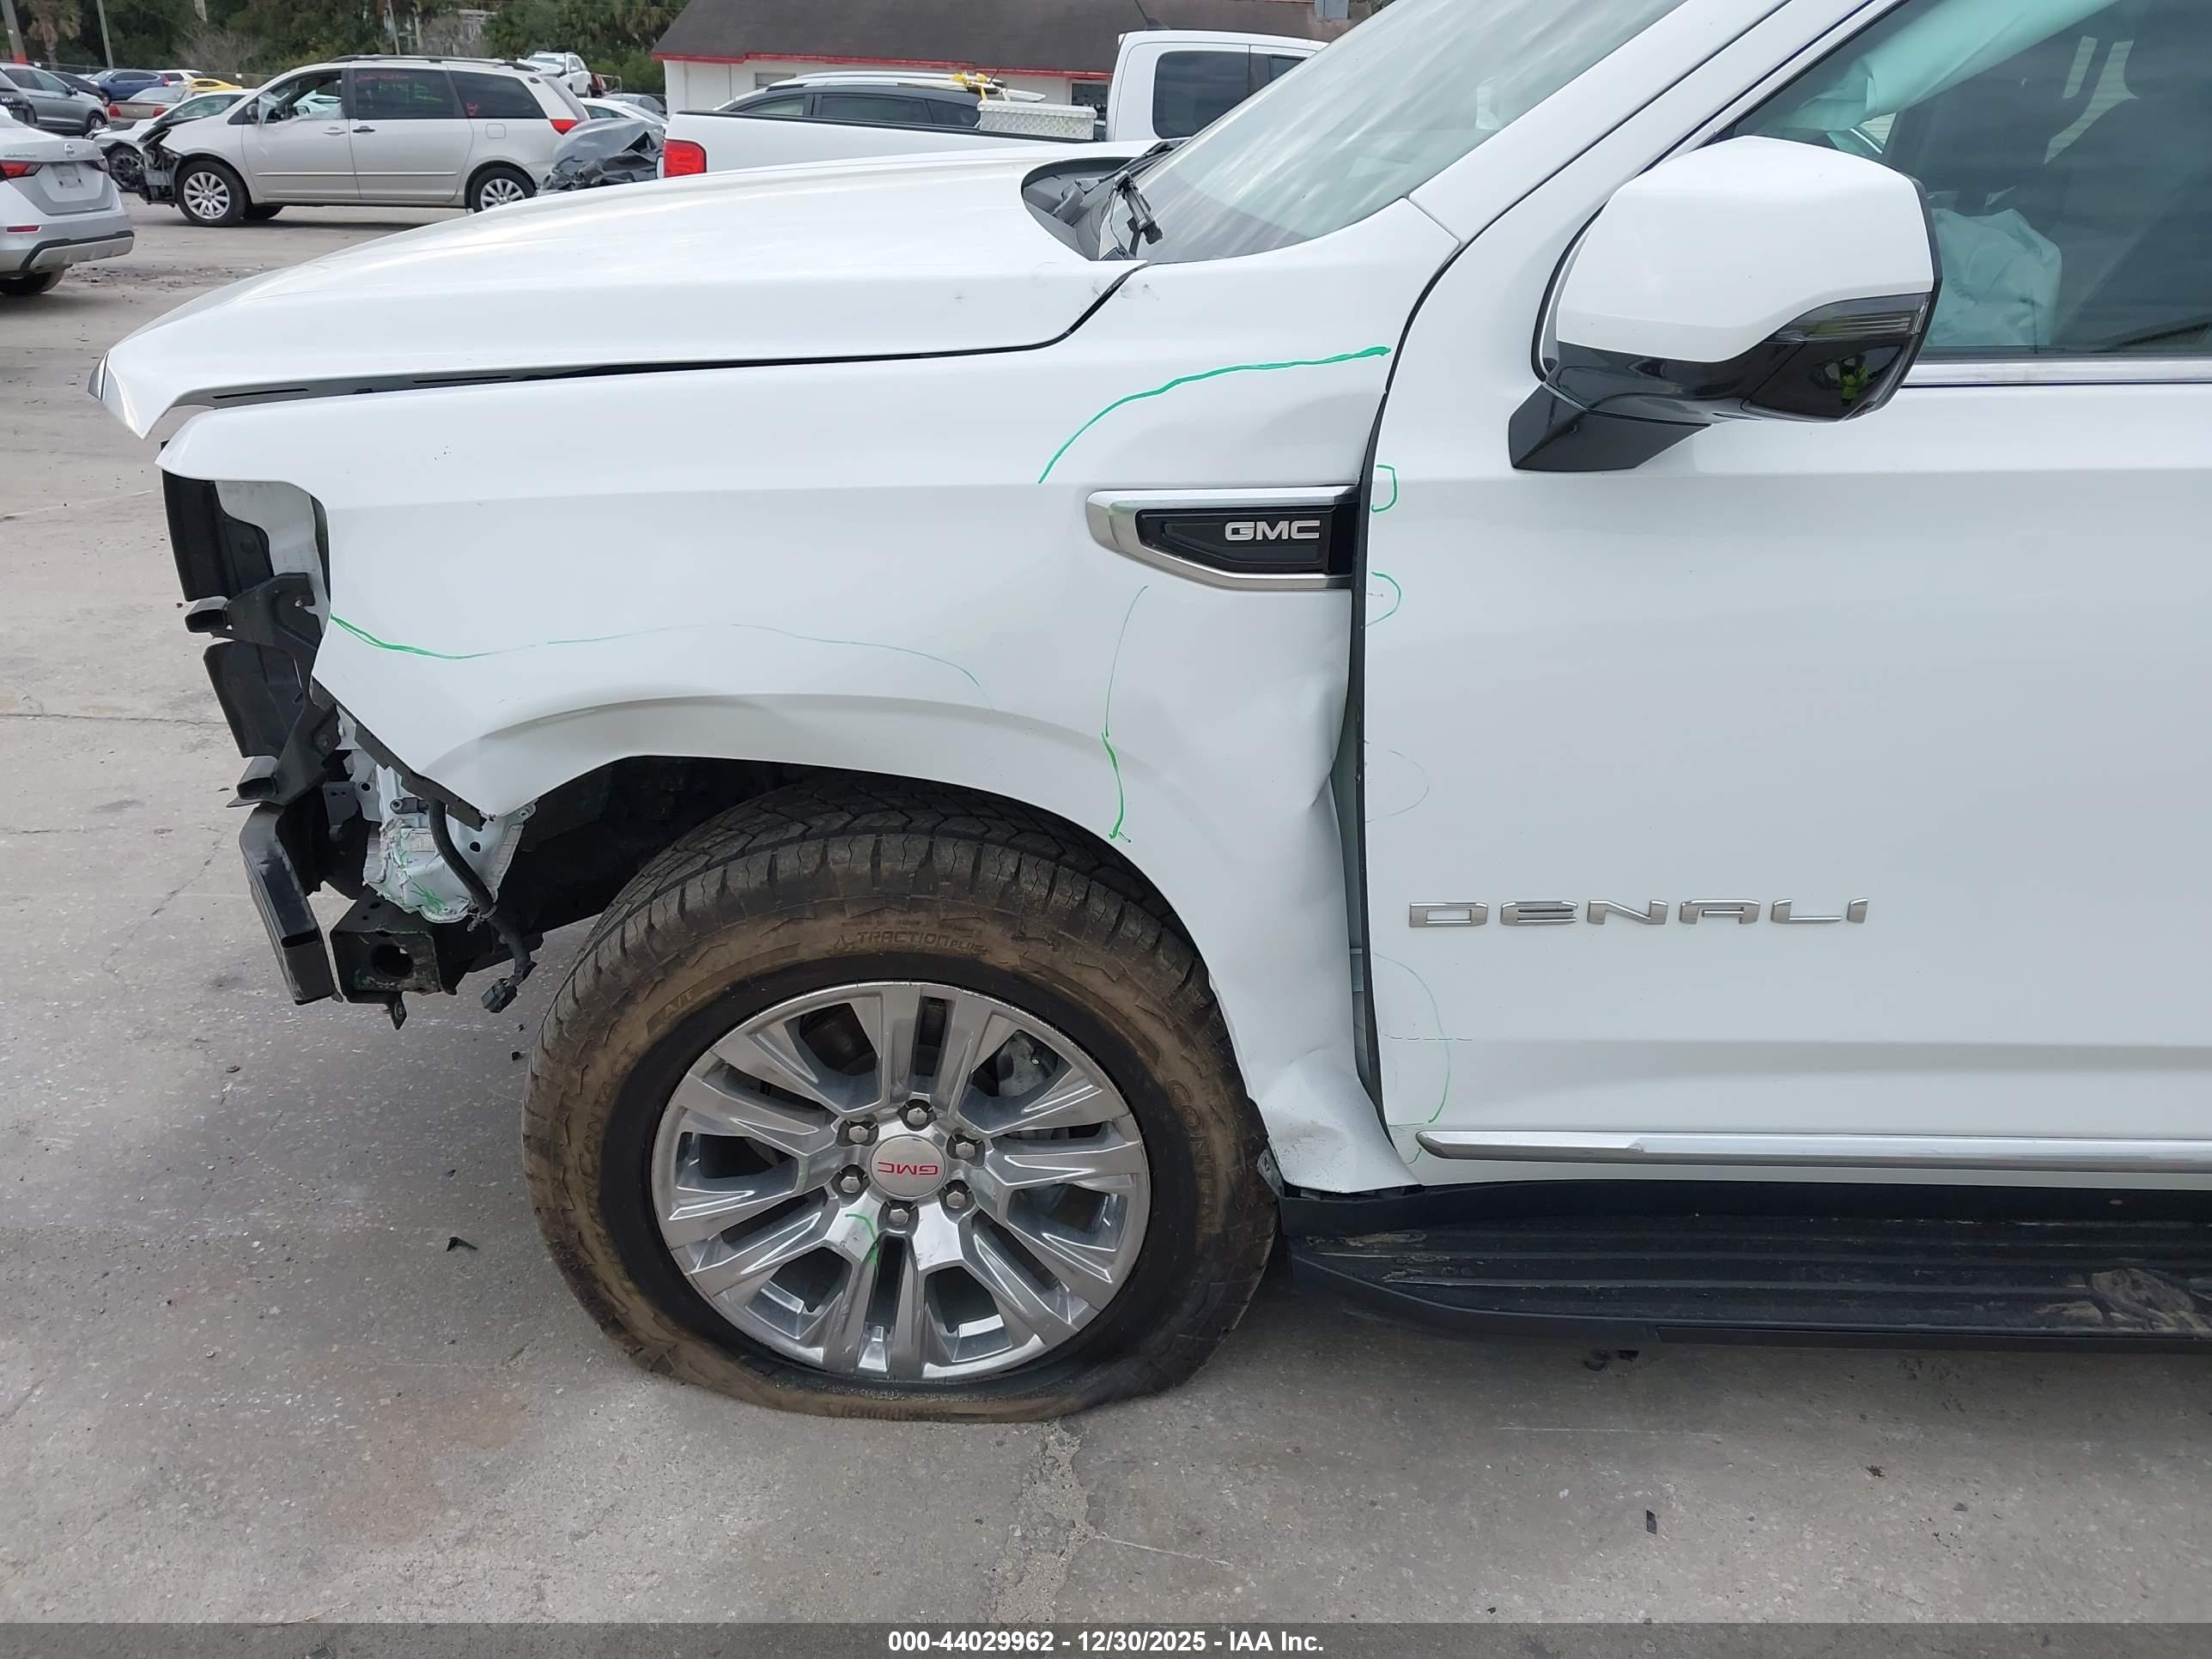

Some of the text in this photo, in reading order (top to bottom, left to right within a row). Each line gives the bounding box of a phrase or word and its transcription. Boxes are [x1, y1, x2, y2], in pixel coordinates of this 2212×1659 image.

[1224, 520, 1321, 541] GMC
[1408, 897, 1870, 928] DENALI
[877, 1161, 939, 1176] GMC
